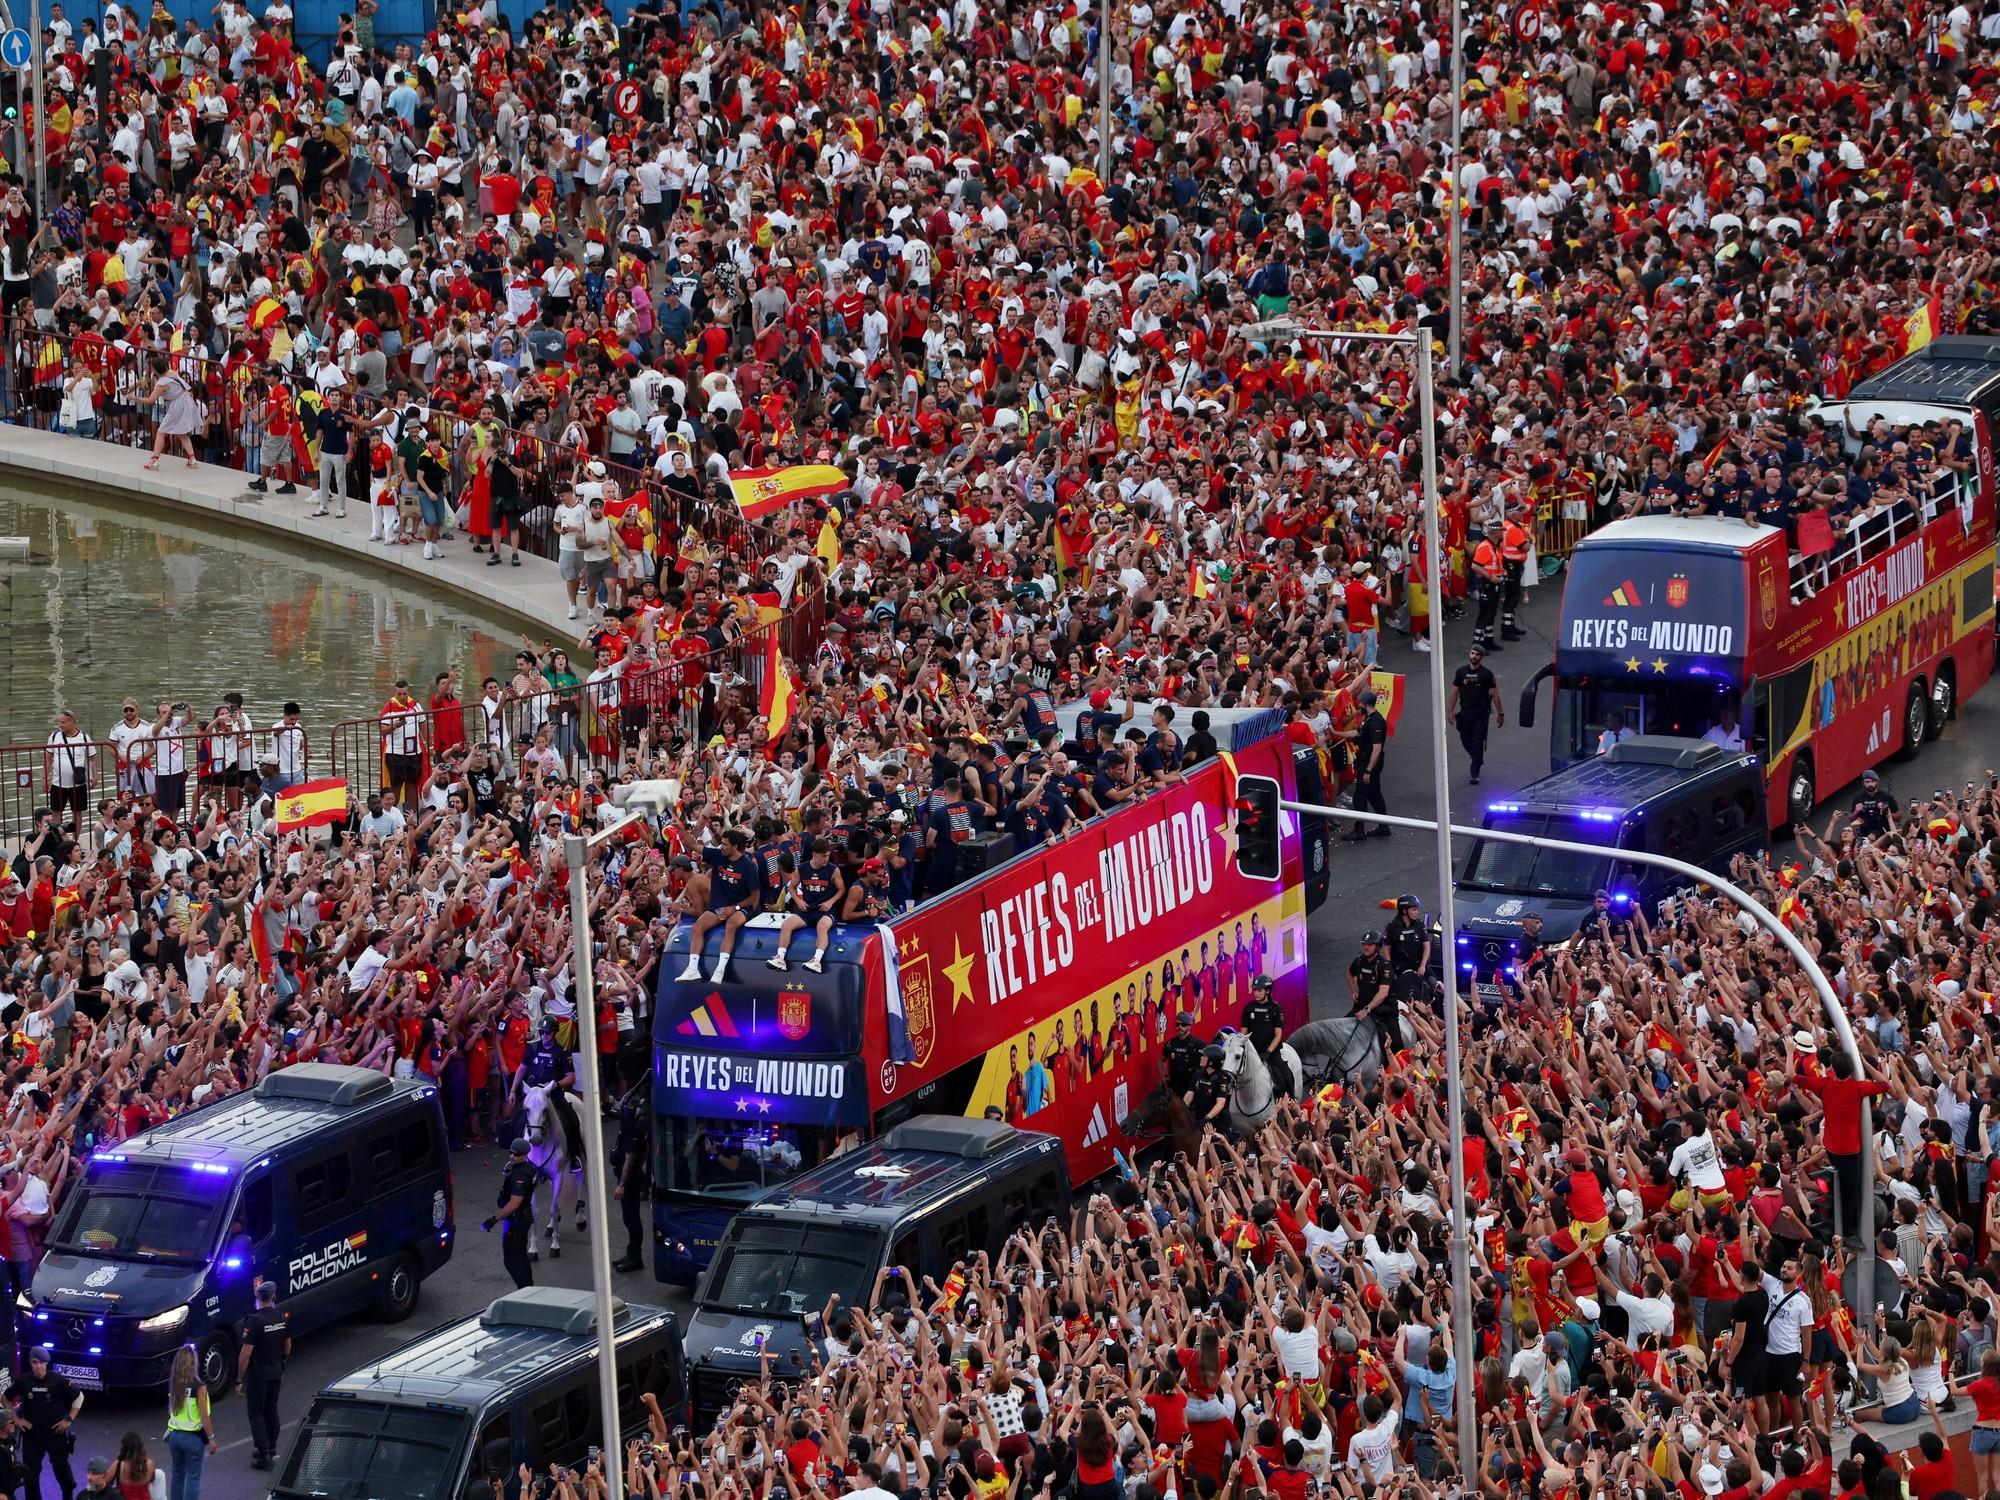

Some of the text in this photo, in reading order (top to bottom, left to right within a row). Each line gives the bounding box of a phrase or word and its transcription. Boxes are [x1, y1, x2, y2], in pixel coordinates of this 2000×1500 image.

[338, 69, 352, 83] 20
[873, 251, 882, 270] 6
[915, 248, 929, 267] 21
[86, 343, 99, 361] 13
[650, 383, 661, 401] 19
[1847, 537, 1924, 630] REYES DEL MUNDO
[1571, 619, 1734, 656] REYES DEL MUNDO
[981, 801, 1214, 1006] REYES DEL MUNDO
[667, 1054, 845, 1099] REYES DEL MUNDO
[694, 1238, 721, 1248] SELE
[1491, 1240, 1505, 1265] 19
[289, 1250, 367, 1294] NACIONAL
